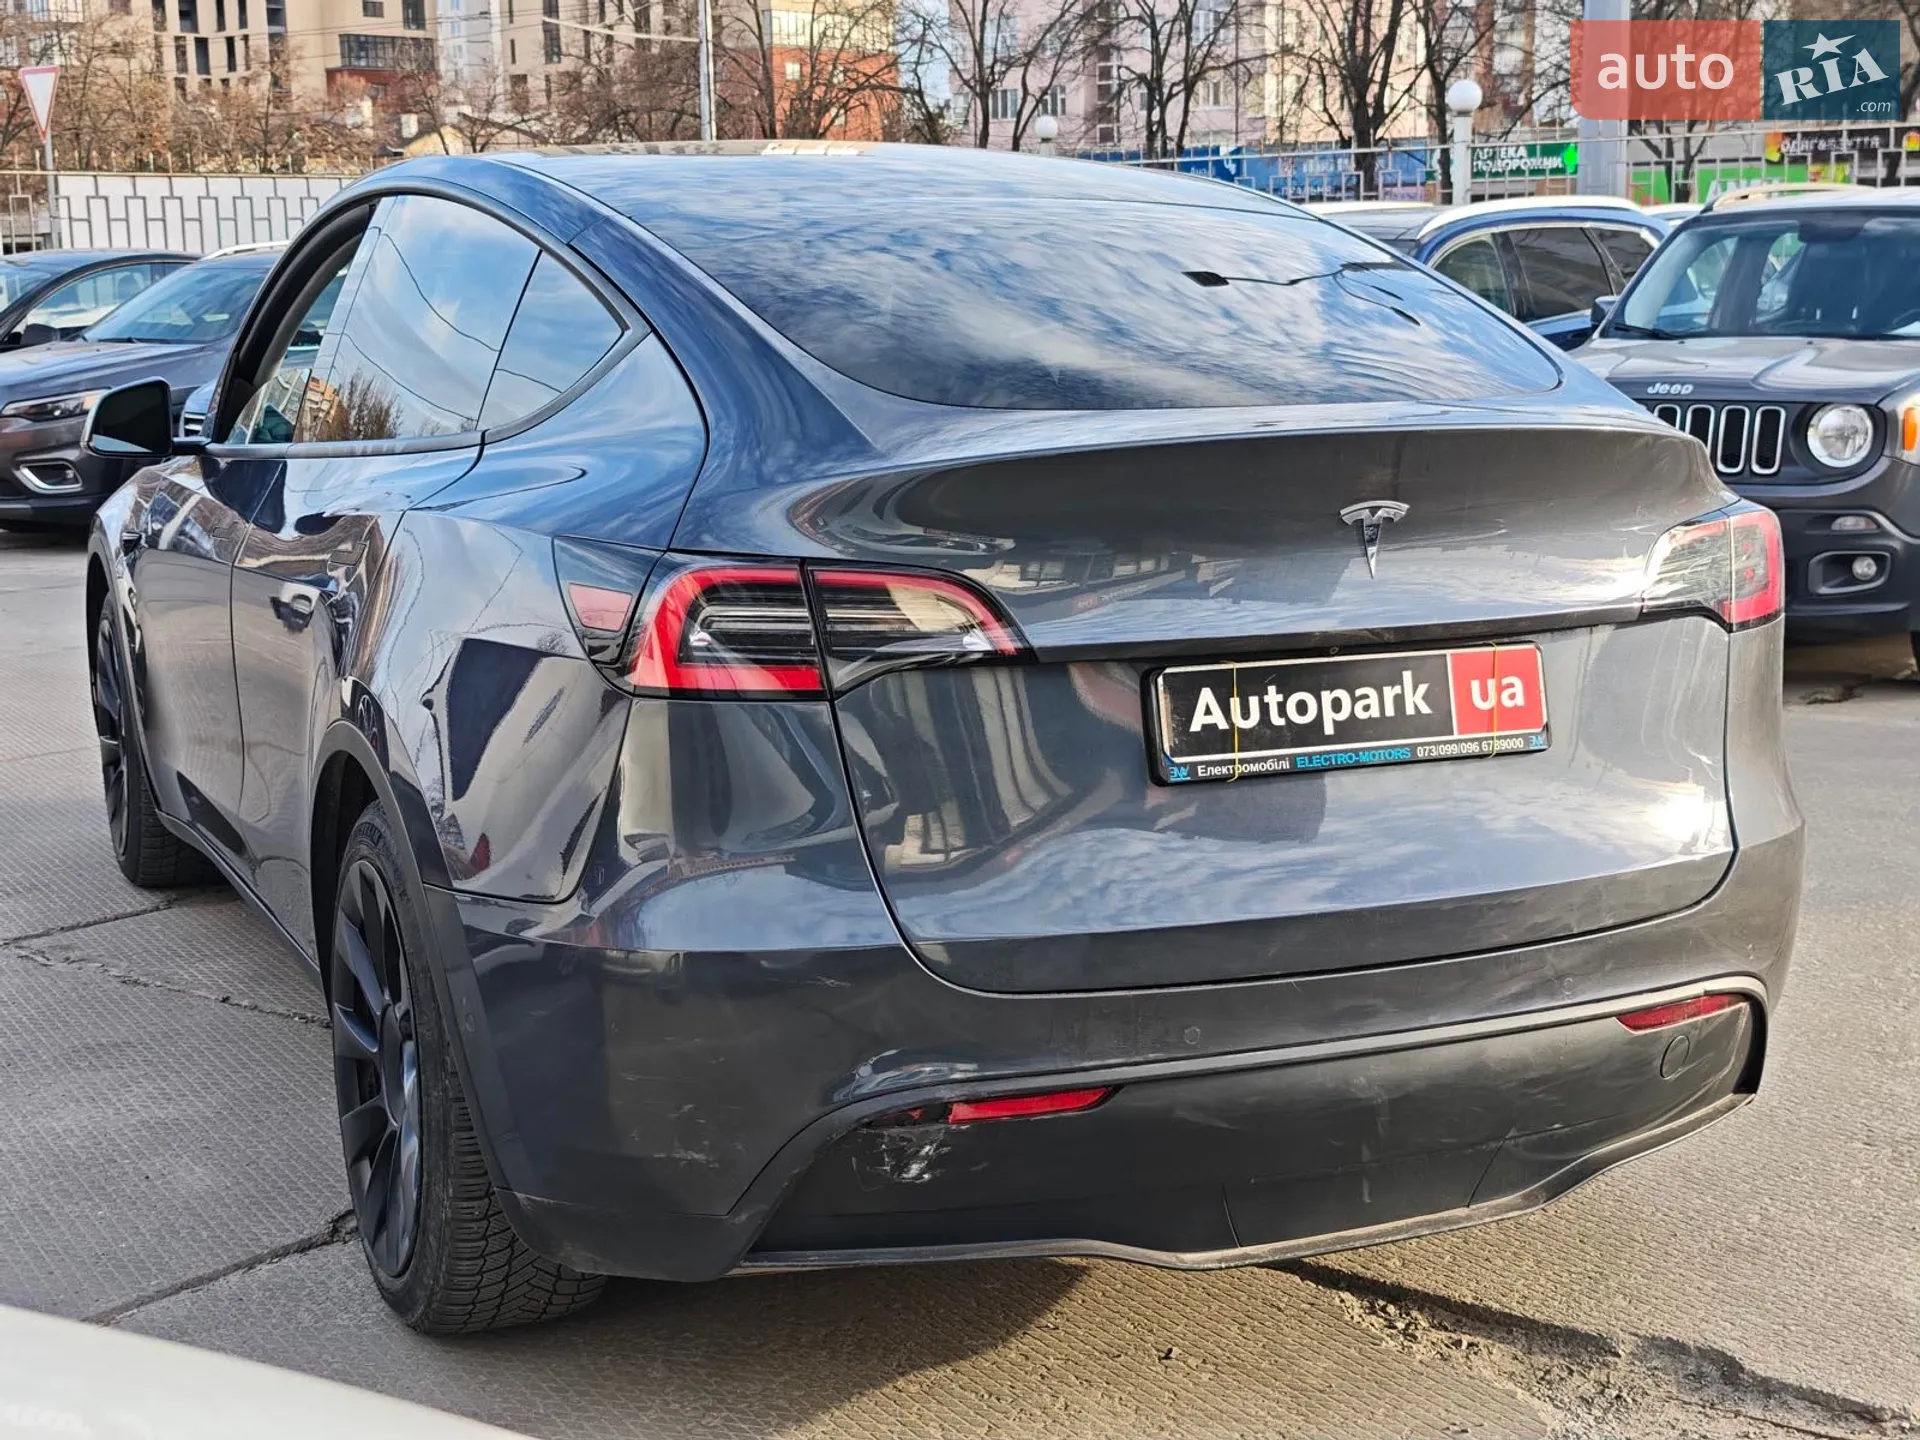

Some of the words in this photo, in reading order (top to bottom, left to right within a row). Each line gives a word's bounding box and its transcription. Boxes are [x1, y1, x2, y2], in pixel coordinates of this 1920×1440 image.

[1474, 146, 1527, 160] АПТЕКА
[1646, 382, 1694, 395] Jeep
[1189, 670, 1432, 736] Autopark
[1470, 675, 1525, 710] ua
[1197, 759, 1290, 777] Електромобілі
[1296, 747, 1411, 768] ELECTRO-MOTORS
